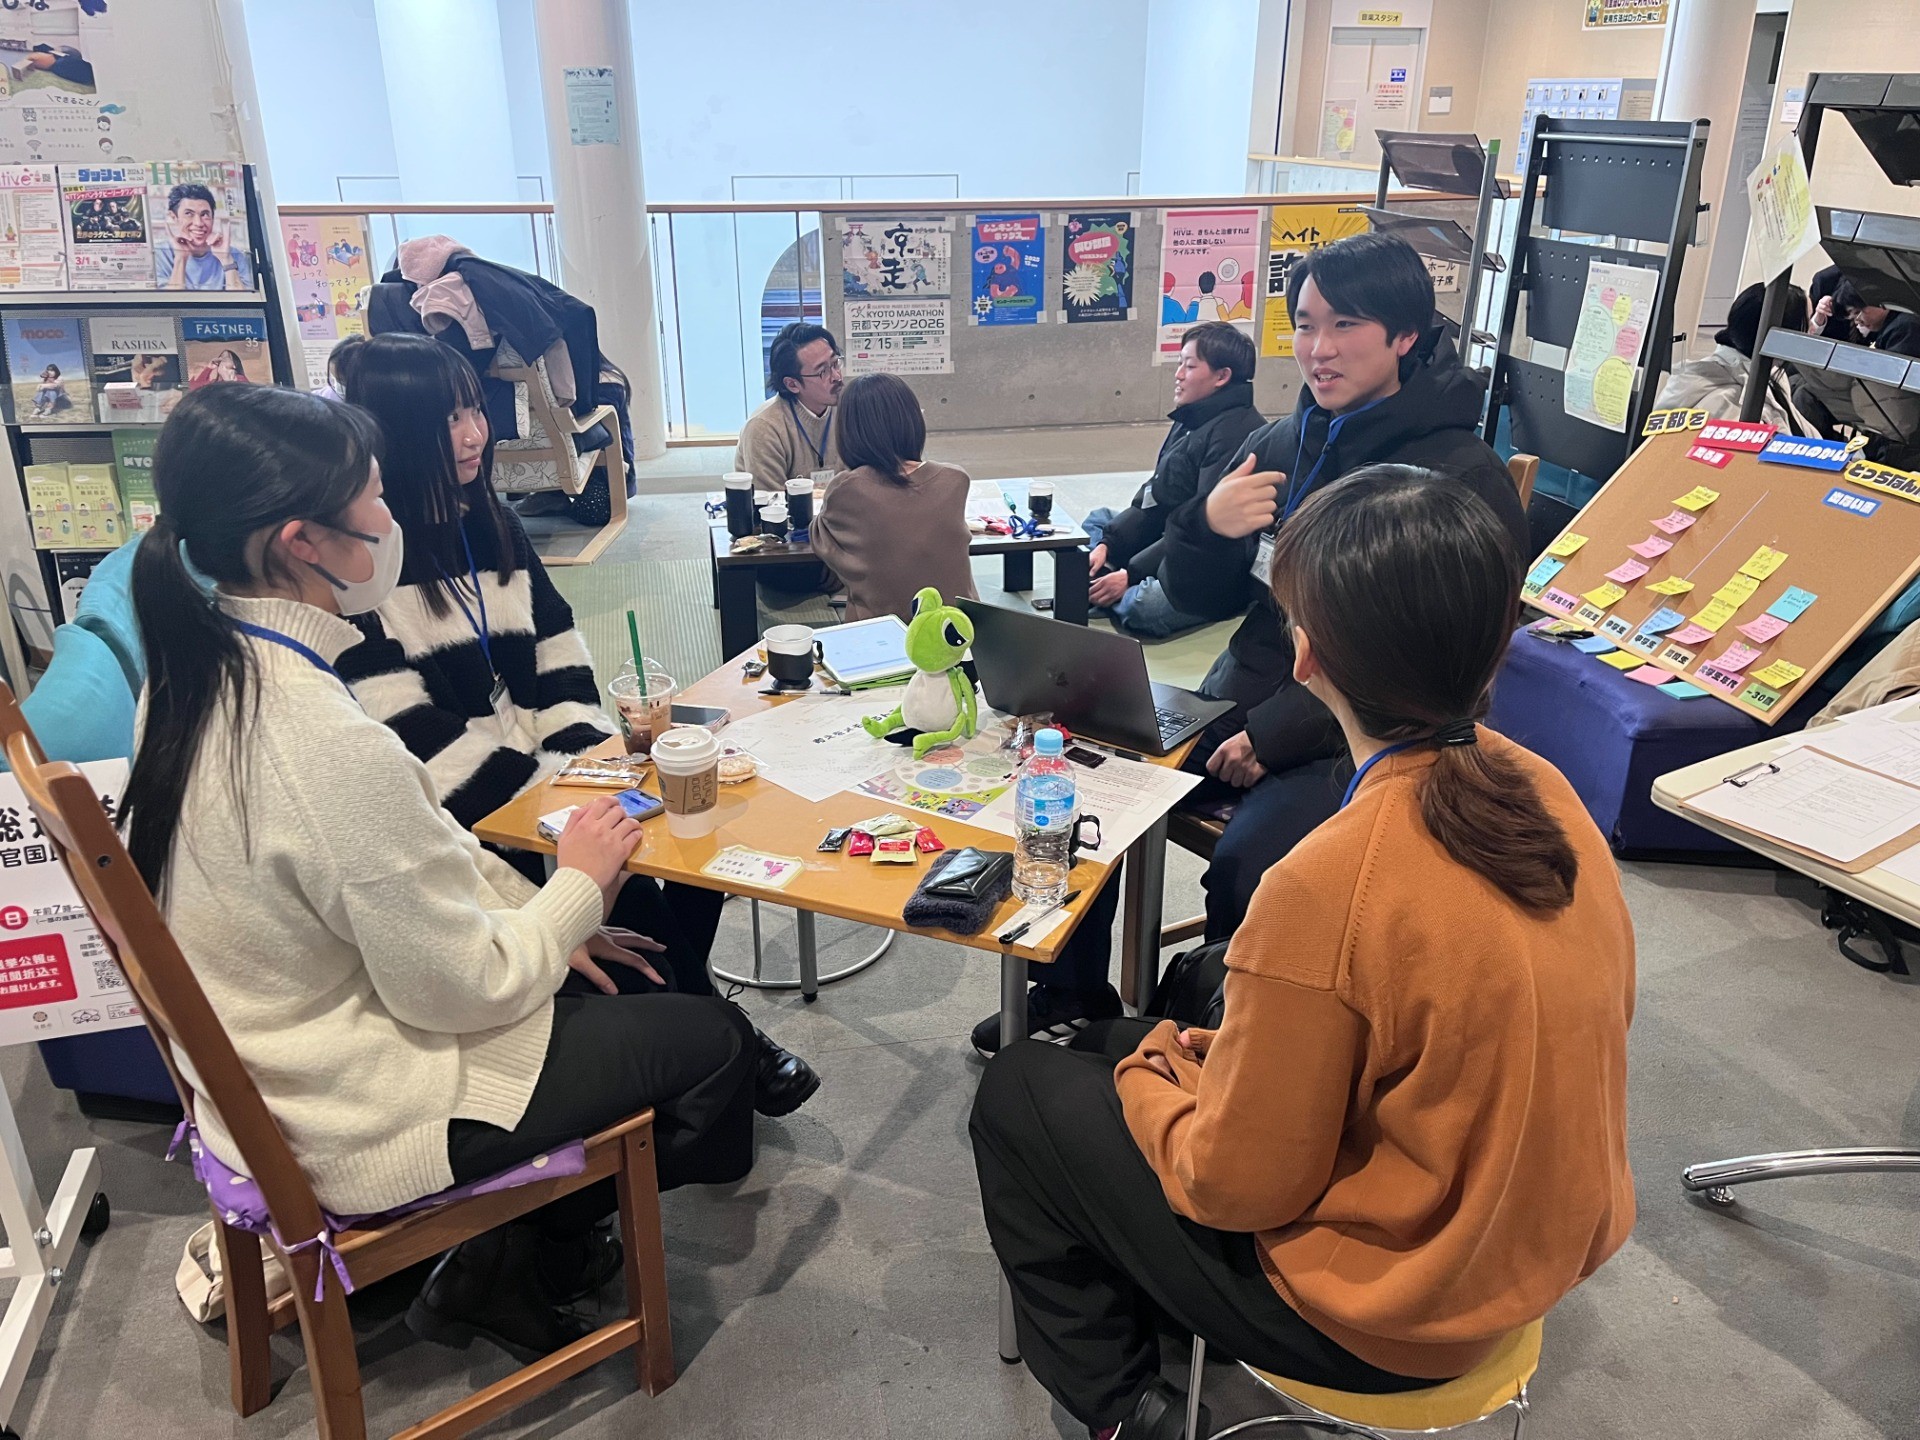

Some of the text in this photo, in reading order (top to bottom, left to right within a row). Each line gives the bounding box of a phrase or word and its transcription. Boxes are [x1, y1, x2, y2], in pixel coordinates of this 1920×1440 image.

[1361, 13, 1399, 22] 音楽スタジオ
[78, 168, 126, 182] ダッシュ!
[1281, 226, 1320, 242] ヘイト
[1172, 238, 1226, 246] 他の人に感染しない
[1172, 248, 1210, 256] ウイルスです。
[75, 256, 91, 265] 3/1
[1427, 261, 1456, 271] ホール
[866, 308, 944, 318] KYOTO MARATHON
[196, 323, 258, 335] FASTNER.
[851, 318, 945, 331] 京都マラソン2026
[111, 340, 167, 350] RASHISA
[245, 337, 259, 348] 35
[1644, 410, 1705, 431] 京都を
[1848, 463, 1920, 497] どっちなん
[1605, 619, 1627, 634] 中学生
[1634, 633, 1658, 649] 中学生
[0, 844, 57, 868] 官国
[5, 911, 21, 926] 日
